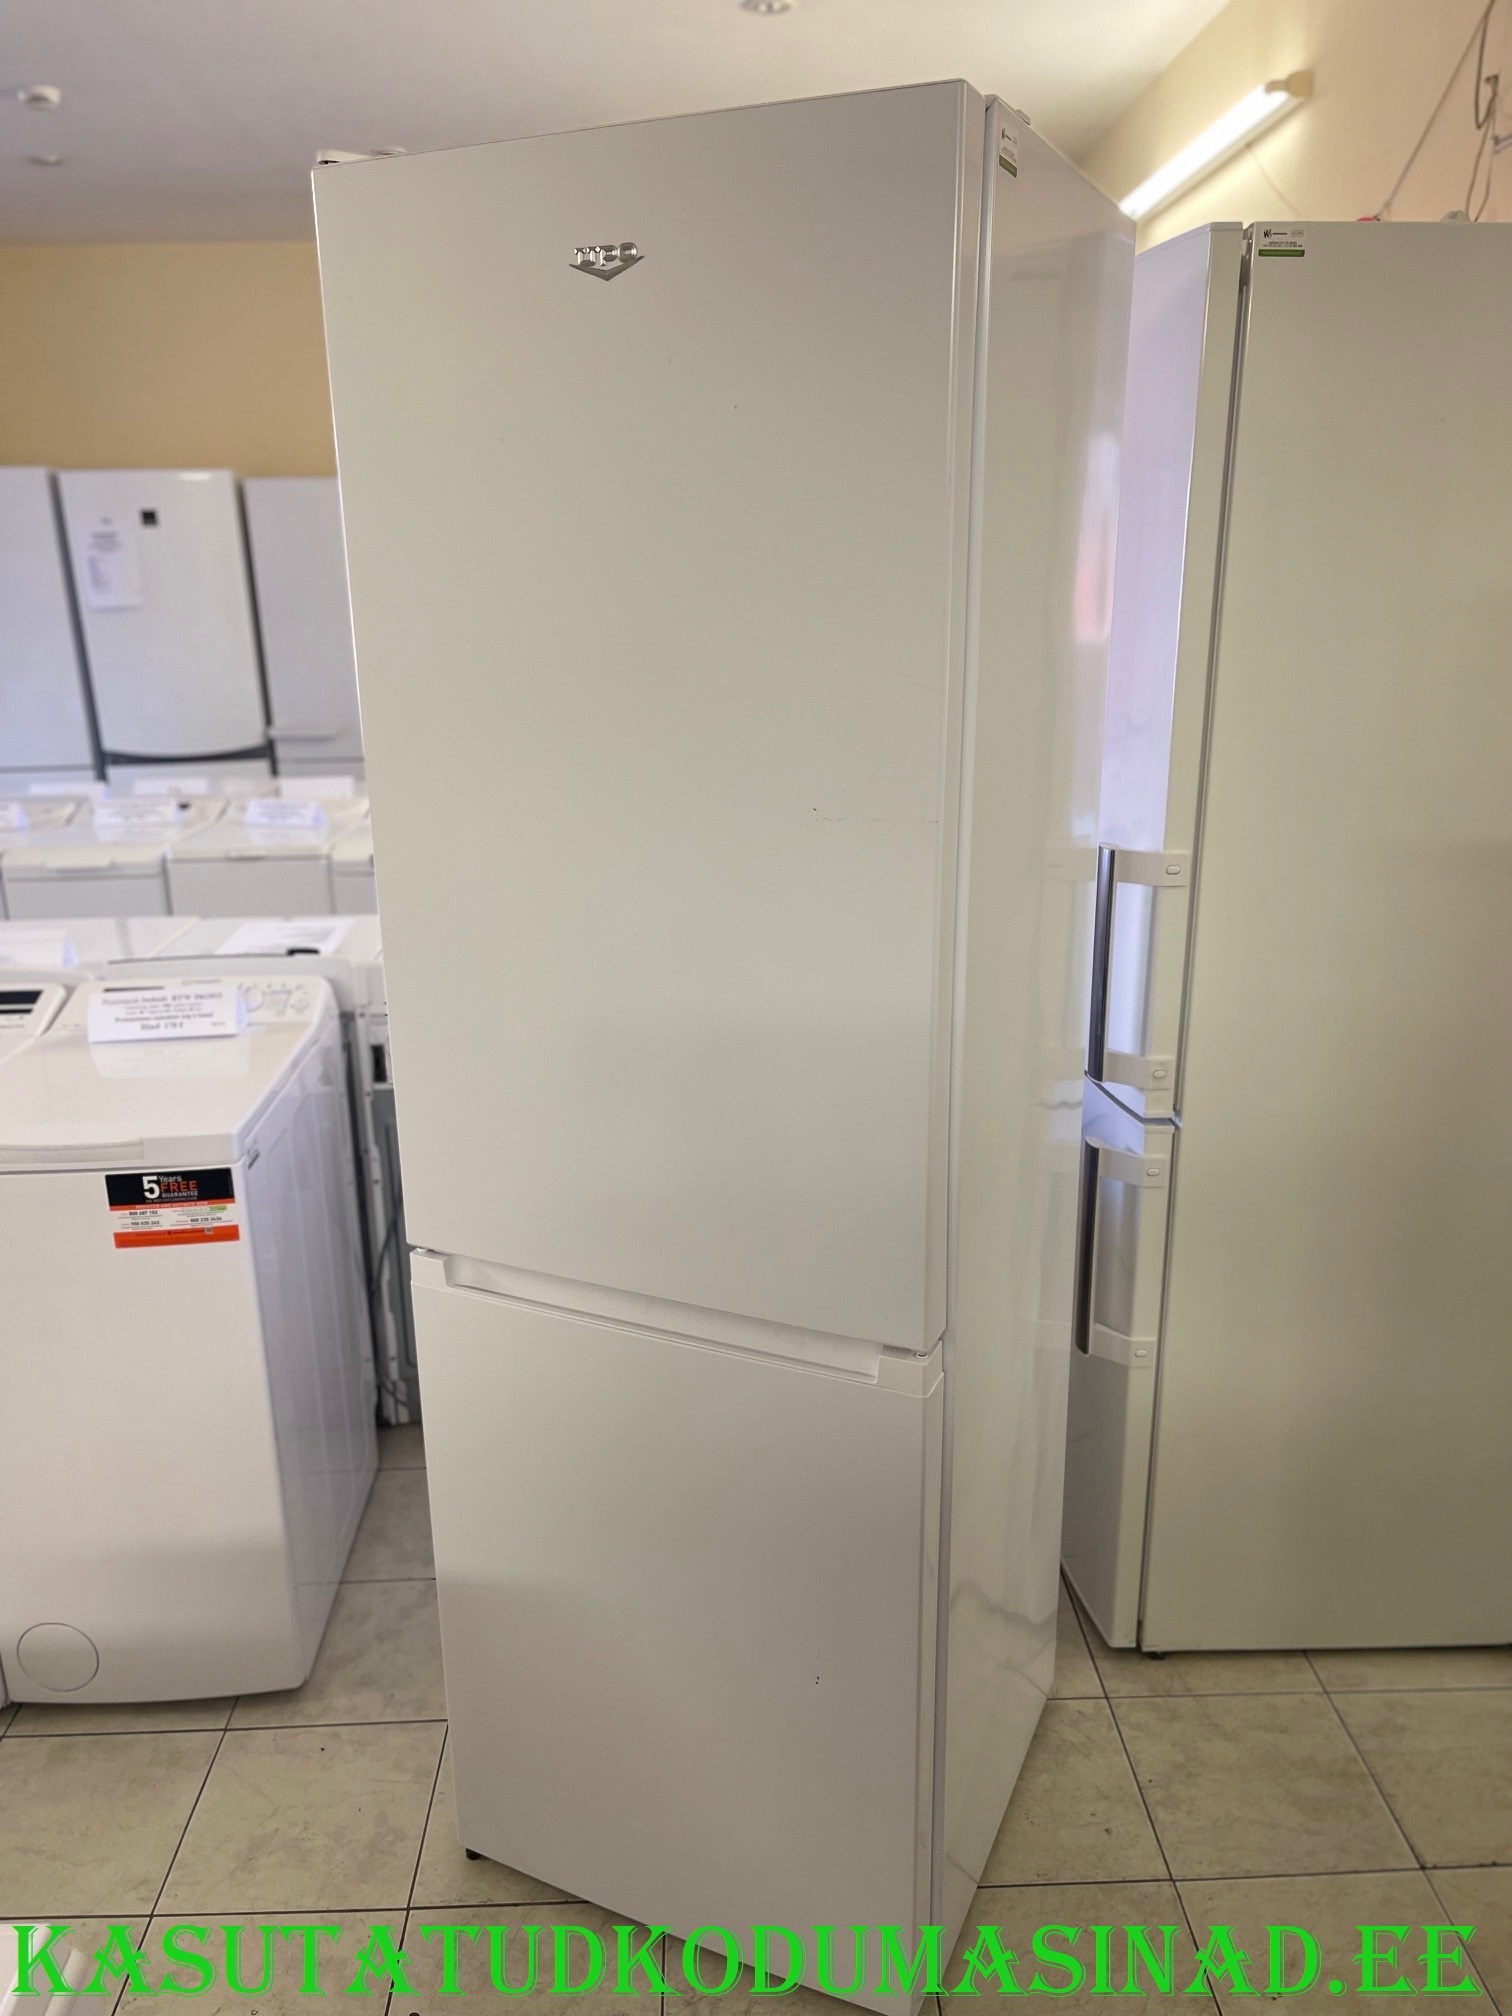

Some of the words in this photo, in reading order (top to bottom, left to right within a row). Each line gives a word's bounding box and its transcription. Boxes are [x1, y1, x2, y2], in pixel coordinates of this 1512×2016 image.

[158, 1175, 182, 1183] Years
[142, 1175, 160, 1199] 5
[160, 1181, 198, 1192] FREE
